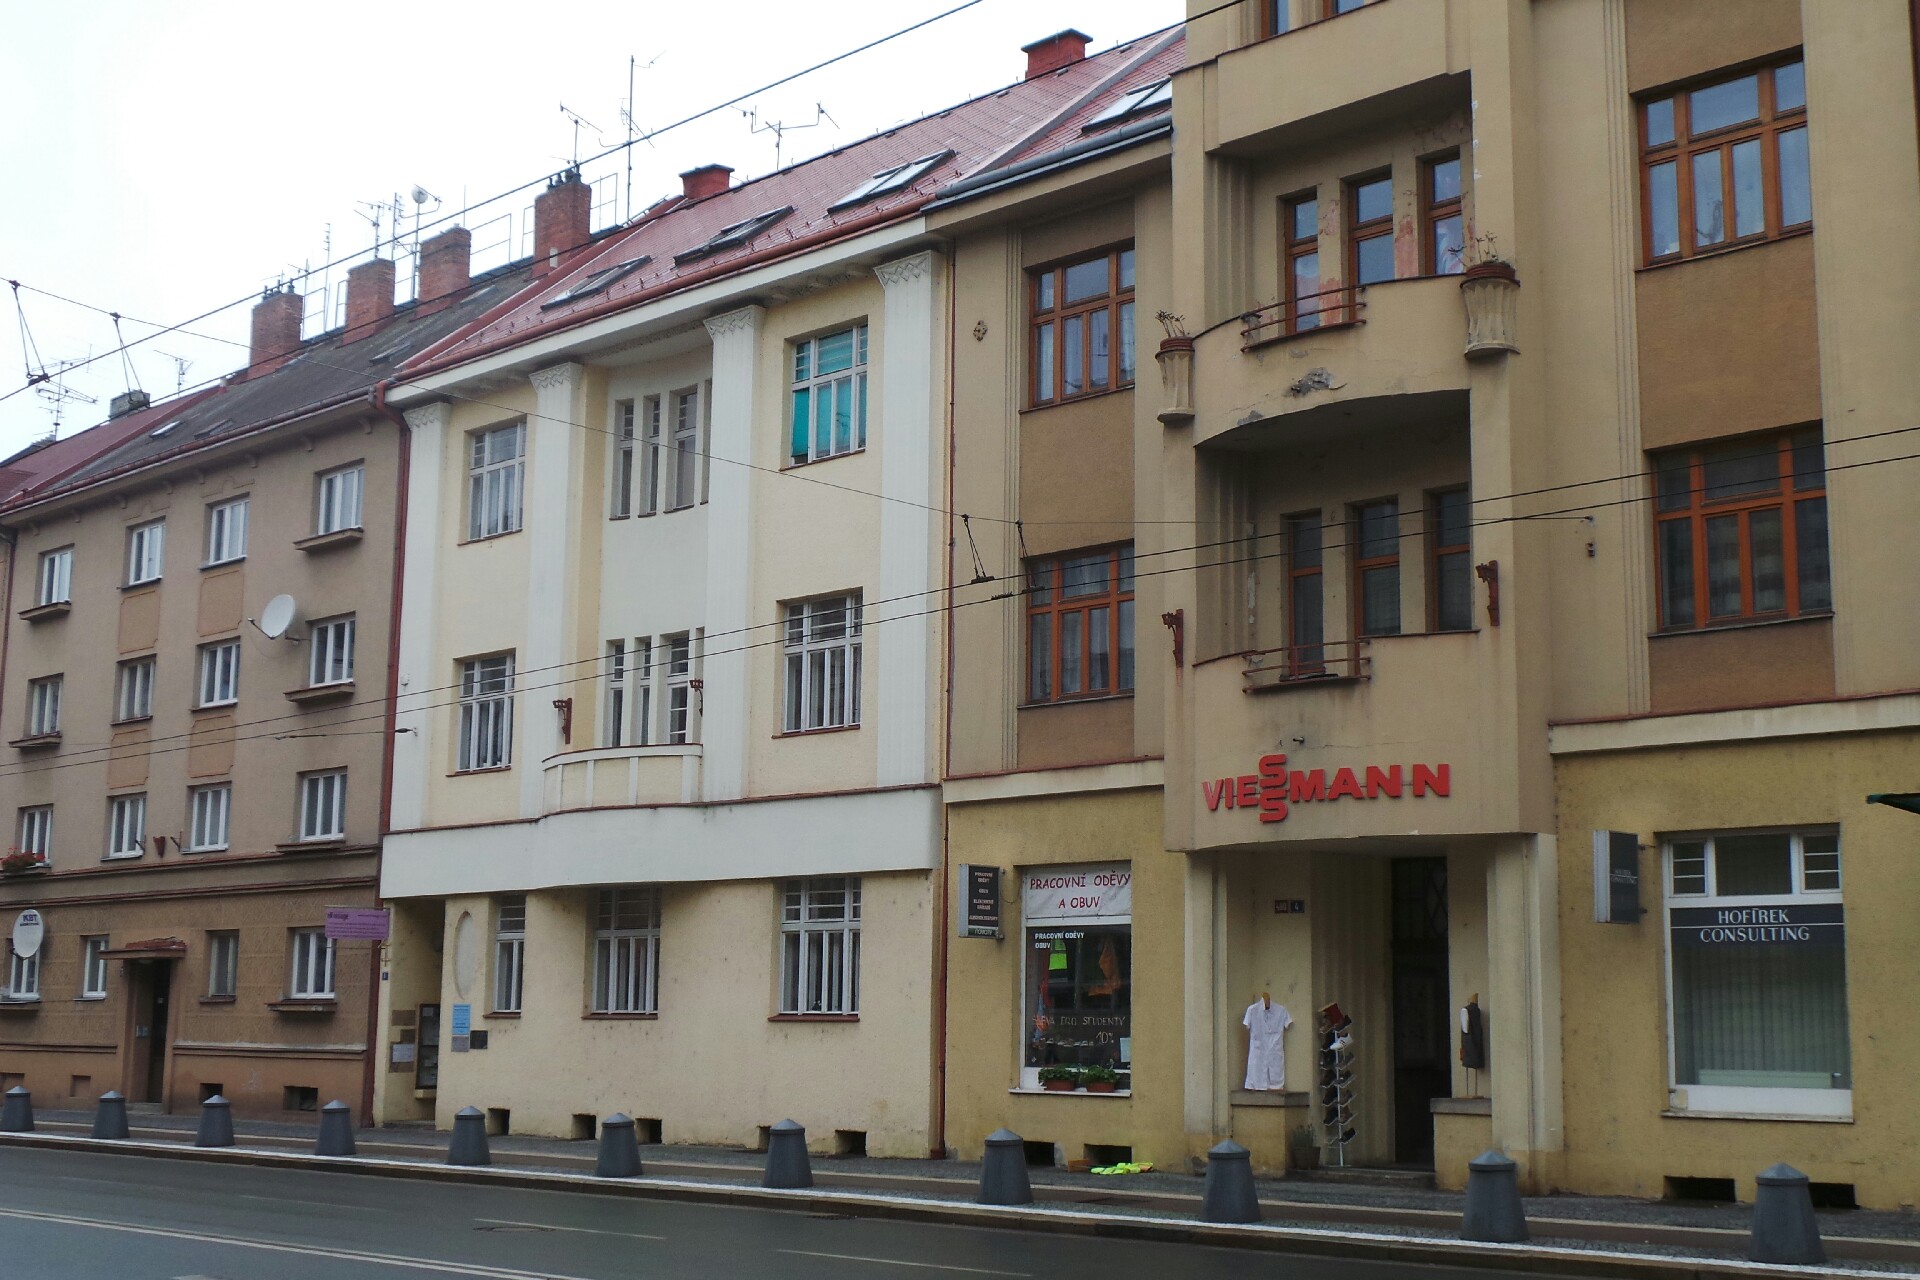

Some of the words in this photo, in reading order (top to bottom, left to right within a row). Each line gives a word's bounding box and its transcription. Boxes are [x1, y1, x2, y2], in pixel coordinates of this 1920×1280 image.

[1201, 753, 1450, 824] VIESSMANN
[1030, 873, 1086, 889] PRACOVNÍ
[1093, 869, 1131, 887] ODĚVY
[1058, 898, 1066, 909] A
[1070, 896, 1101, 909] OBUV
[1035, 931, 1064, 939] PRACOVNÍ
[1065, 930, 1085, 939] ODĚVY
[1699, 926, 1810, 943] CONSULTING
[1082, 1016, 1126, 1027] STUDENTY
